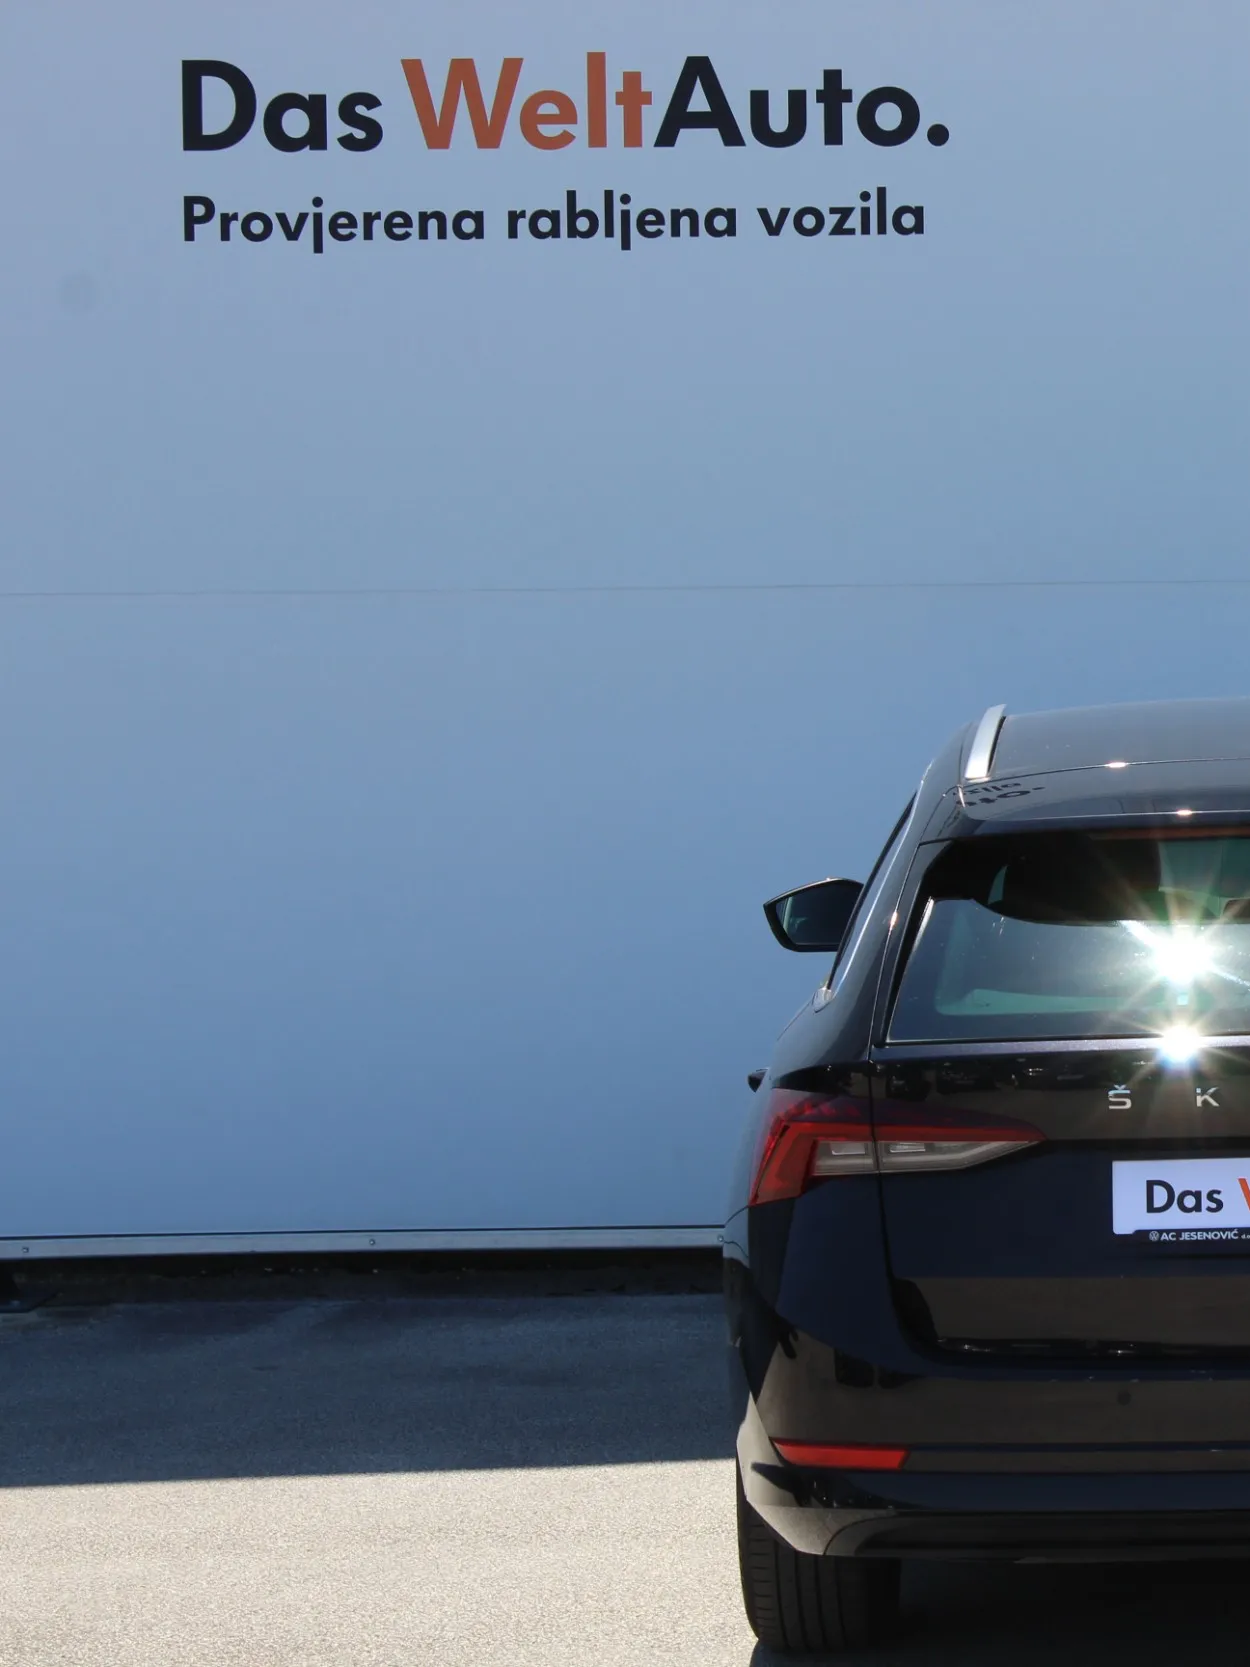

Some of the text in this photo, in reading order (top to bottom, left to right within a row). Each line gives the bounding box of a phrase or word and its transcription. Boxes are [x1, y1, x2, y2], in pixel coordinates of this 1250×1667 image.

[181, 51, 950, 153] Das WeltAuto.
[183, 186, 925, 254] Provjerena rabljena vozila
[1145, 1179, 1224, 1214] Das
[1160, 1231, 1177, 1241] AC
[1179, 1228, 1239, 1241] JESENOVIĆ
